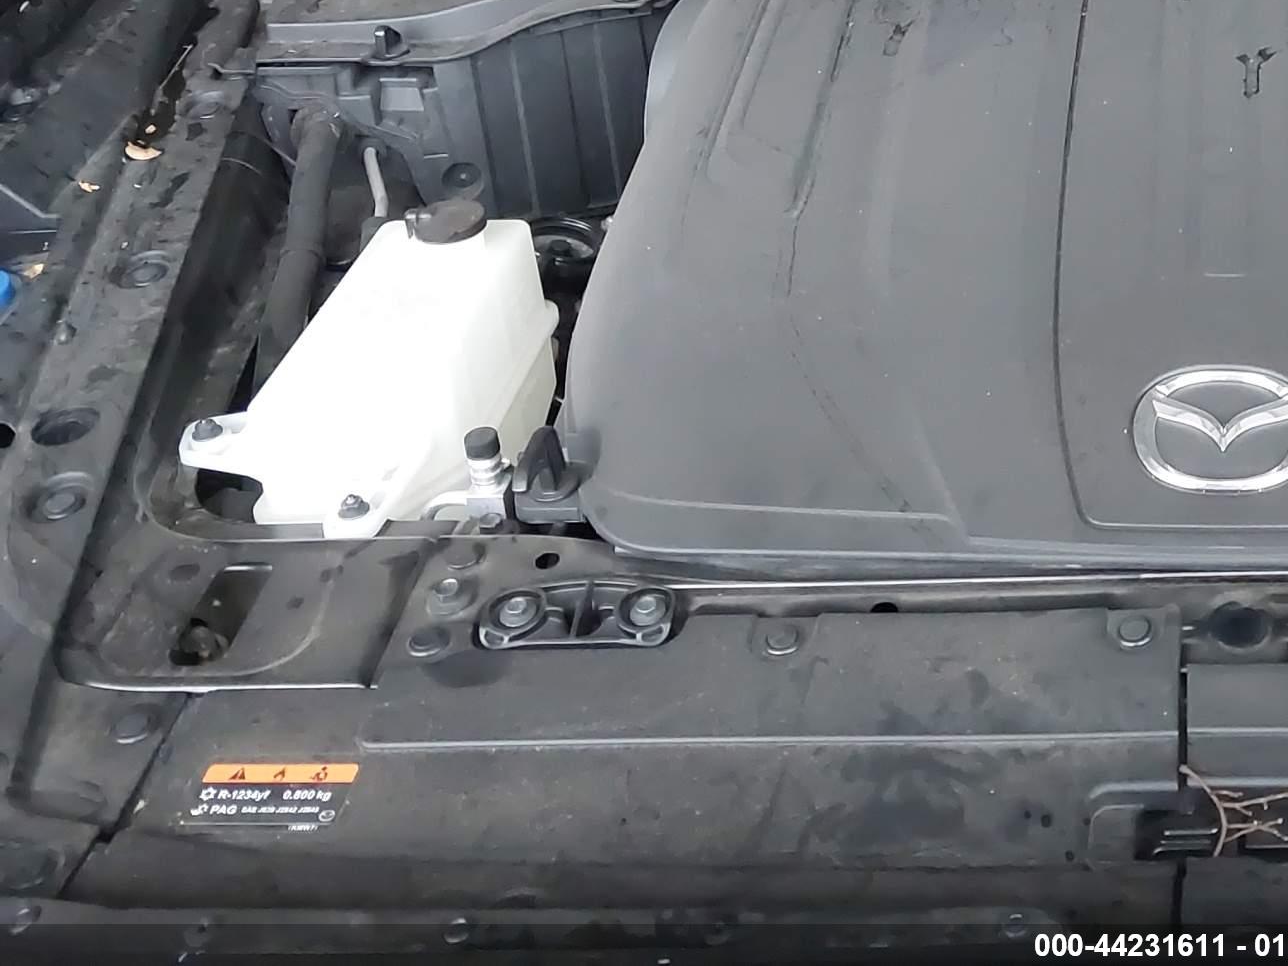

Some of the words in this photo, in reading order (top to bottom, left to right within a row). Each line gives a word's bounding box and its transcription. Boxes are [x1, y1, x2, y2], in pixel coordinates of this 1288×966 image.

[217, 789, 271, 801] R-1234yf
[316, 789, 332, 802] kg
[209, 804, 237, 814] PAG
